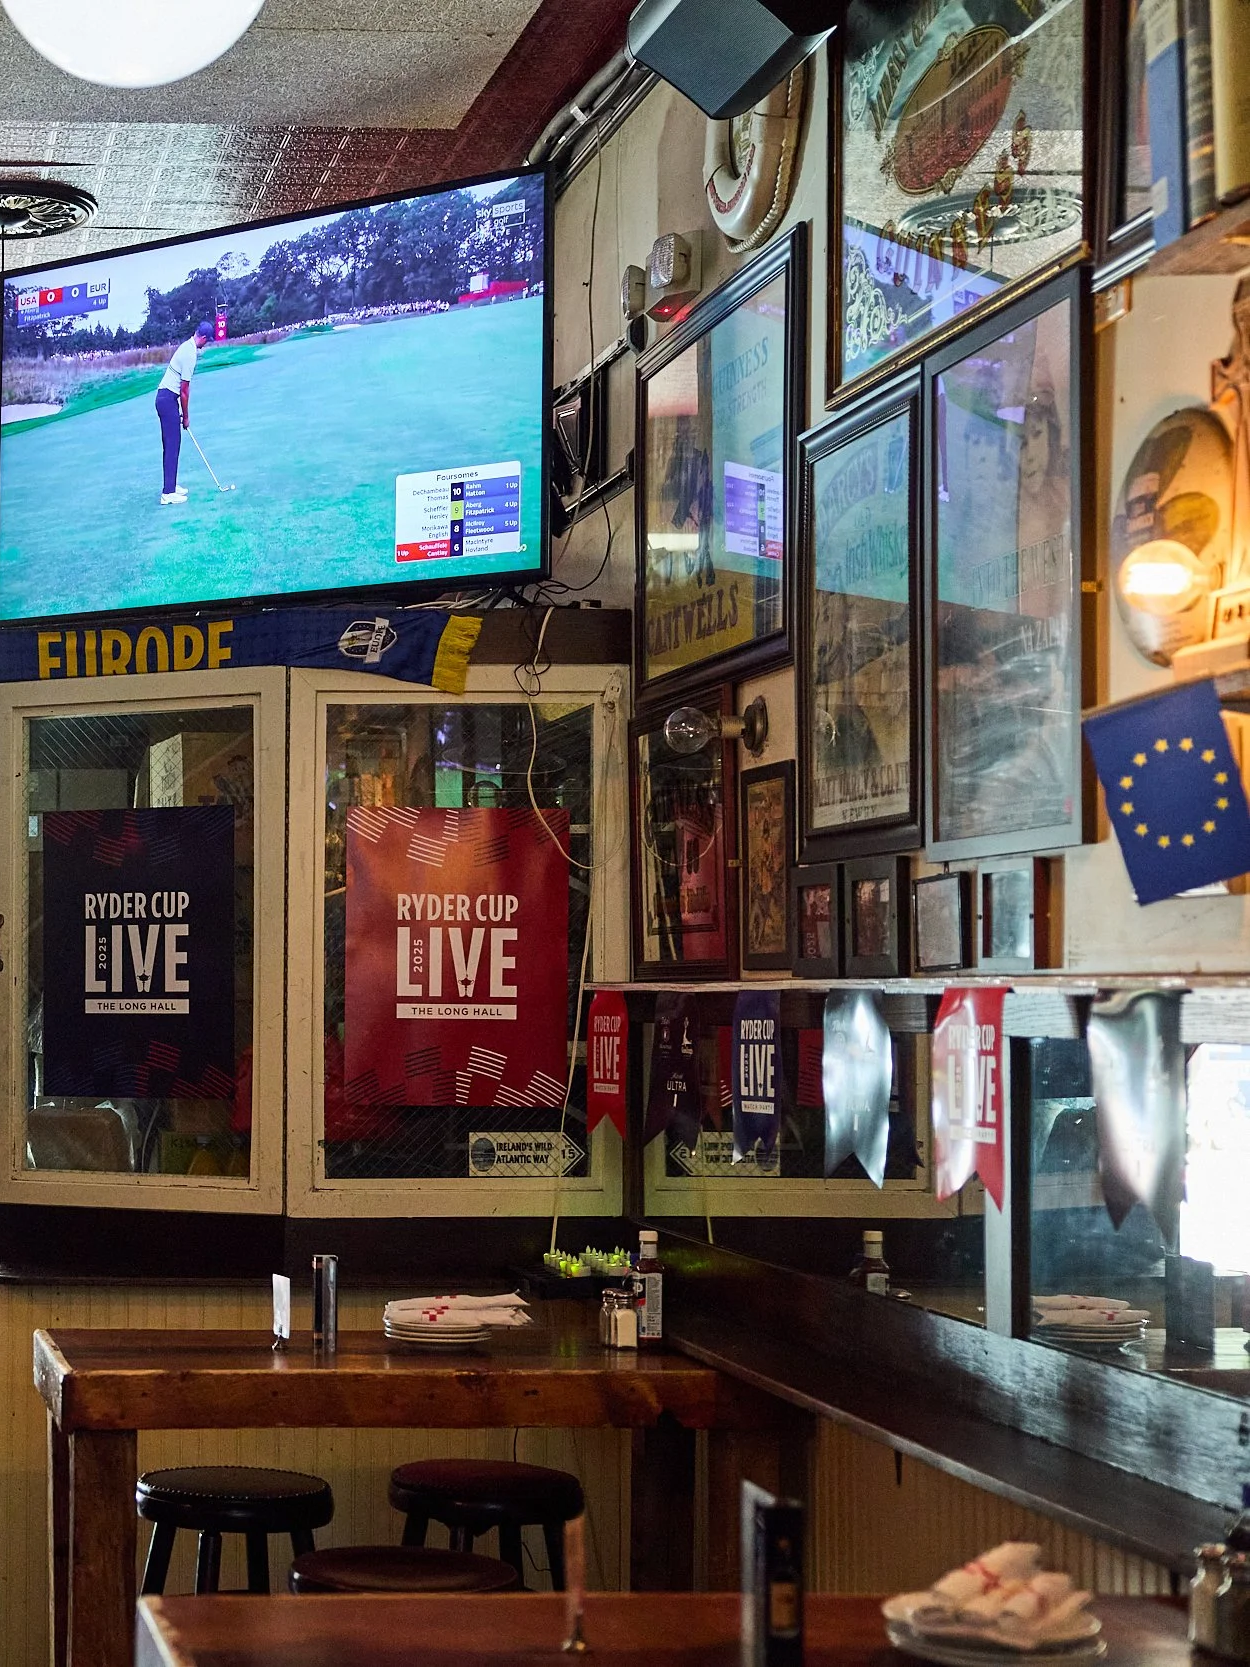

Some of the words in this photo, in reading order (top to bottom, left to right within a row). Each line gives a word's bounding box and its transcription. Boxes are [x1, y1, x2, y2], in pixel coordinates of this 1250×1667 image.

[476, 208, 492, 219] sky
[494, 203, 523, 215] sports
[20, 297, 37, 306] USA
[46, 292, 55, 302] 0
[71, 287, 80, 298] 0
[90, 283, 107, 293] EUR
[436, 471, 479, 481] Foursomes
[412, 487, 450, 496] DeChambeau
[452, 488, 462, 496] 10
[465, 507, 495, 516] Fitzpatrick
[453, 525, 460, 533] 8
[465, 526, 495, 535] Fleetwood
[465, 545, 489, 553] Hovland
[85, 893, 147, 919] RYDER
[151, 891, 190, 918] CUP
[397, 893, 471, 921] RYDER
[475, 894, 519, 922] CUP
[85, 923, 190, 993] LIVE
[98, 936, 107, 970] 2025
[413, 939, 423, 973] 2025
[396, 926, 518, 998] LIVE
[119, 1003, 146, 1011] LONG
[150, 1003, 176, 1011] HALL
[412, 1007, 433, 1015] THE
[437, 1007, 469, 1016] LONG
[473, 1008, 503, 1016] HALL
[594, 1015, 611, 1033] RYDER
[611, 1015, 621, 1033] CUP
[740, 1019, 762, 1040] RYDER
[762, 1019, 775, 1040] CUP
[981, 1024, 996, 1051] CUP
[593, 1036, 621, 1080] LIVE
[740, 1044, 775, 1098] LIVE
[666, 1081, 687, 1092] ULTRA
[496, 1143, 533, 1151] IRELAND'S
[535, 1143, 553, 1151] WILD
[496, 1155, 532, 1164] ATLANTIC
[533, 1155, 550, 1163] WAY
[561, 1149, 576, 1160] 15
